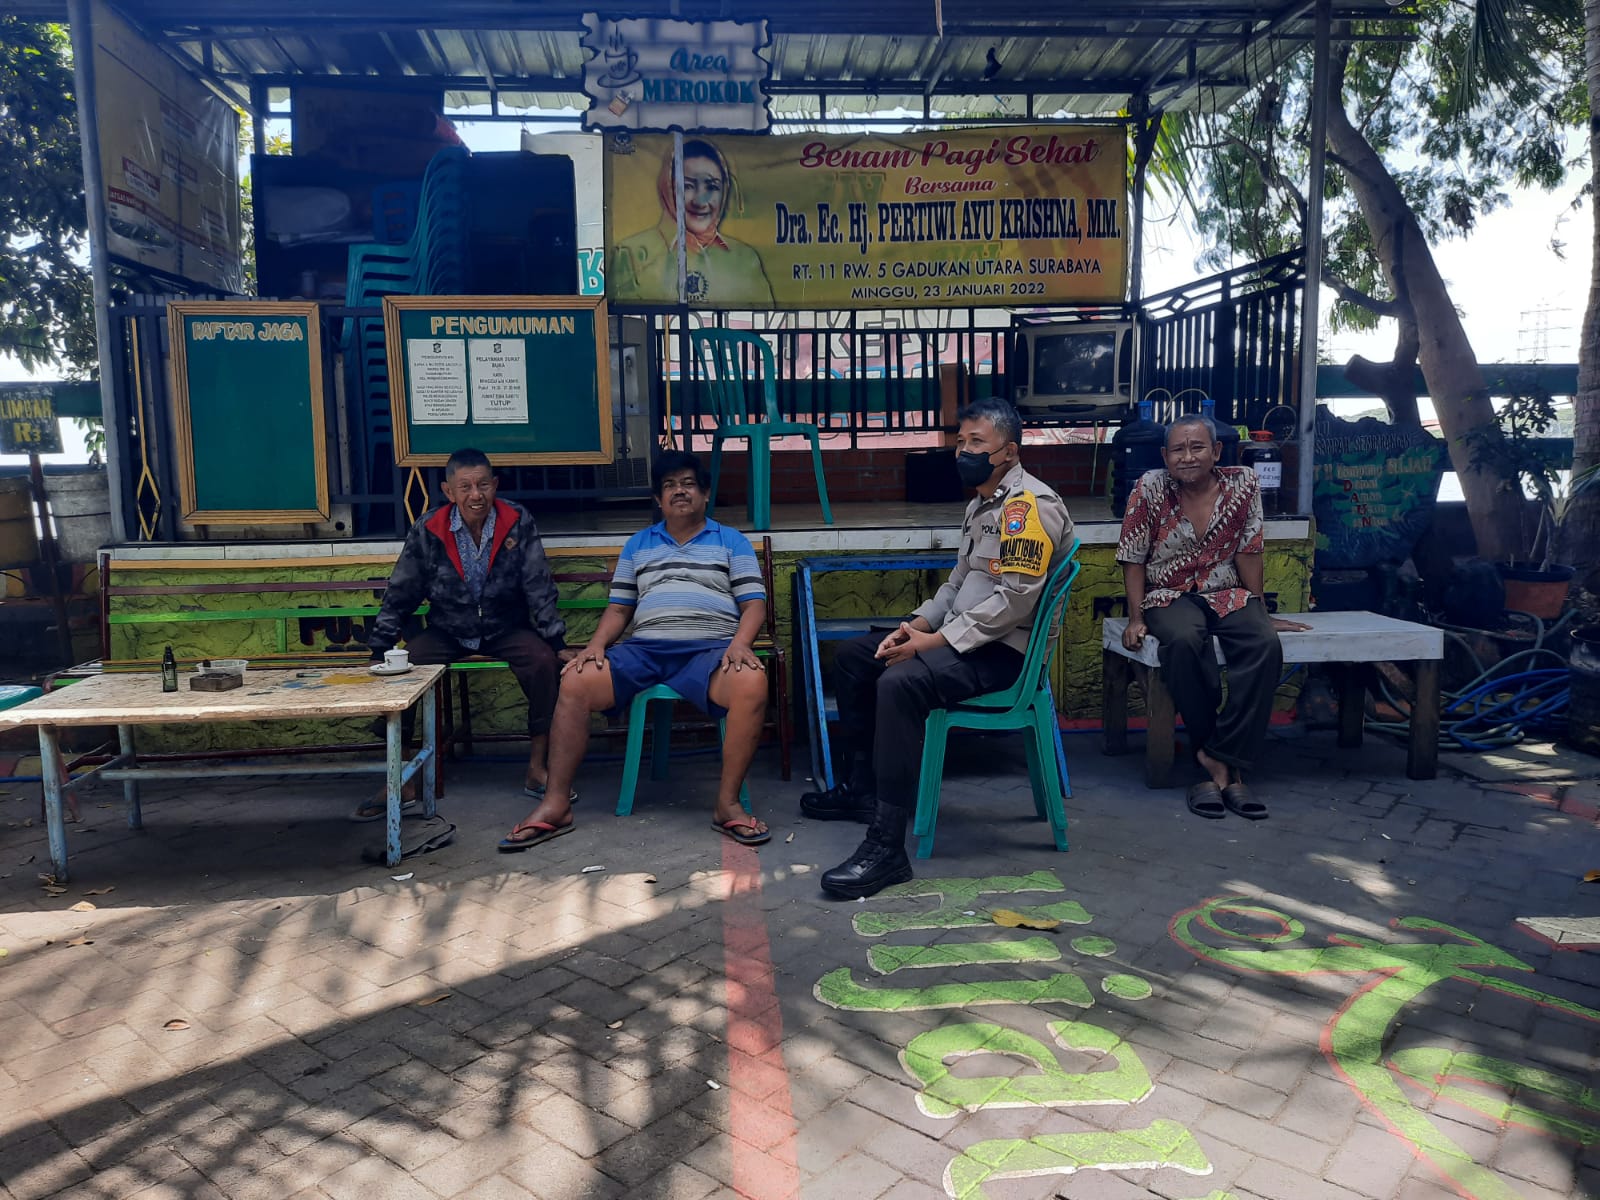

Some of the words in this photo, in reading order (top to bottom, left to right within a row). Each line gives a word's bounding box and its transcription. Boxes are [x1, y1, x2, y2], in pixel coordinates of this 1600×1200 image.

[669, 47, 730, 74] Area
[642, 78, 756, 104] MEROKOK
[799, 141, 917, 169] Senam
[922, 138, 1002, 175] Pagi
[1004, 135, 1100, 165] Sehat
[904, 176, 997, 196] Bersama
[776, 202, 812, 244] Dra.
[816, 202, 843, 243] Ec.
[848, 203, 872, 255] Hj.
[878, 200, 956, 242] PERTIWI
[960, 199, 995, 241] AYU
[999, 198, 1082, 244] KRISHNA,
[1086, 198, 1121, 240] MM.
[793, 263, 813, 280] RT.
[819, 263, 836, 279] 11
[843, 262, 871, 279] RW.
[877, 262, 887, 278] 5
[892, 260, 971, 278] GADUKAN
[975, 259, 1023, 276] UTARA
[1028, 257, 1101, 275] SURABAYA
[851, 285, 919, 300] MINGGU,
[923, 284, 941, 297] 23
[946, 283, 1005, 297] JANUARI
[1009, 282, 1047, 296] 2022
[258, 321, 303, 341] JAGA
[430, 315, 575, 336] PENGUMUMAN
